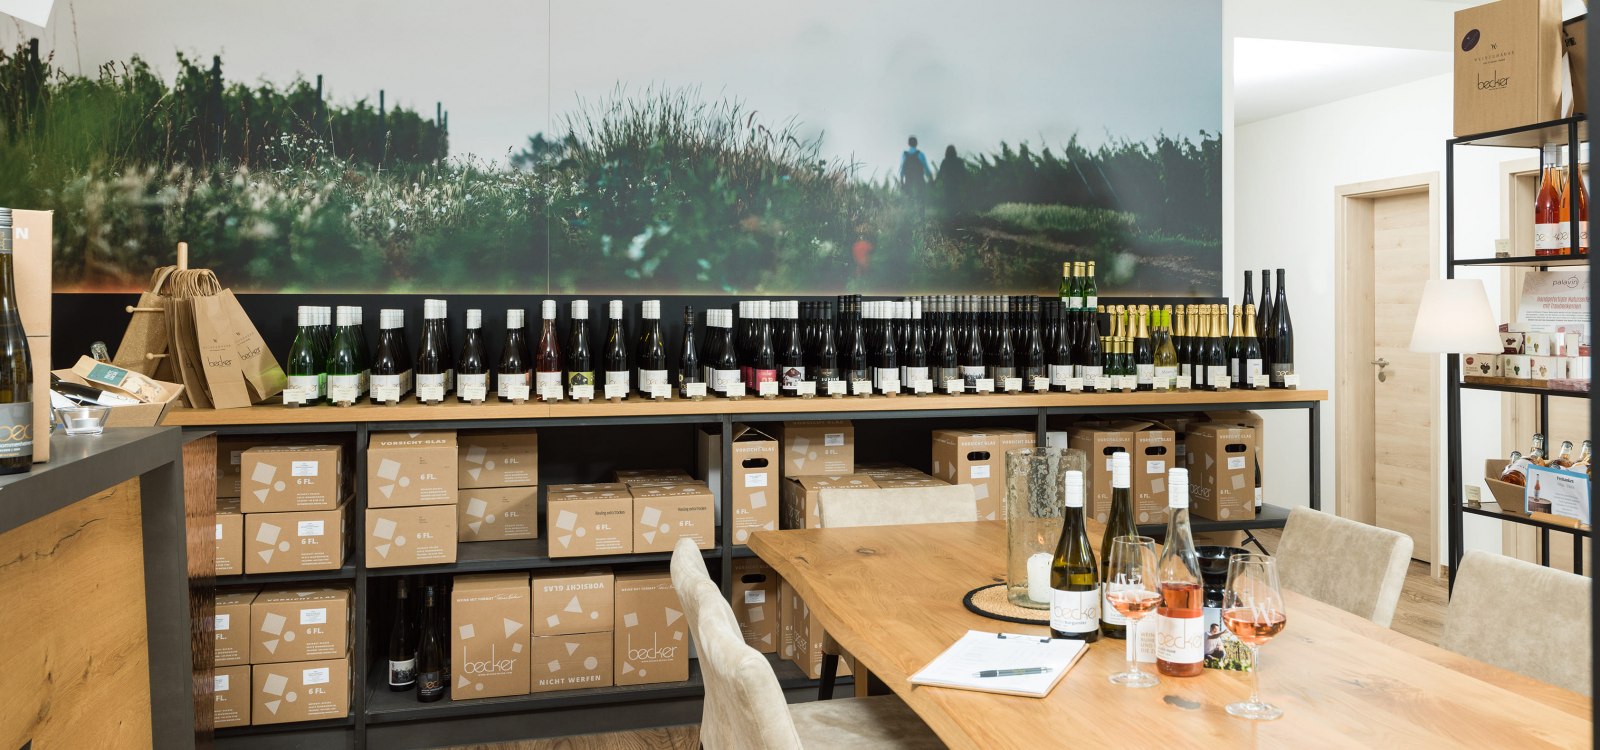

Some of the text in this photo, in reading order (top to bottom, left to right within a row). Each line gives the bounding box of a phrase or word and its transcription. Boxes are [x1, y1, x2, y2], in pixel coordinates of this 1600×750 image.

[1477, 70, 1510, 90] becker
[1552, 279, 1578, 287] palavin
[565, 582, 604, 591] VORSICHT
[306, 627, 312, 635] 6
[628, 632, 678, 661] becker
[463, 643, 517, 674] becker
[539, 675, 601, 686] NICHT WERFEN
